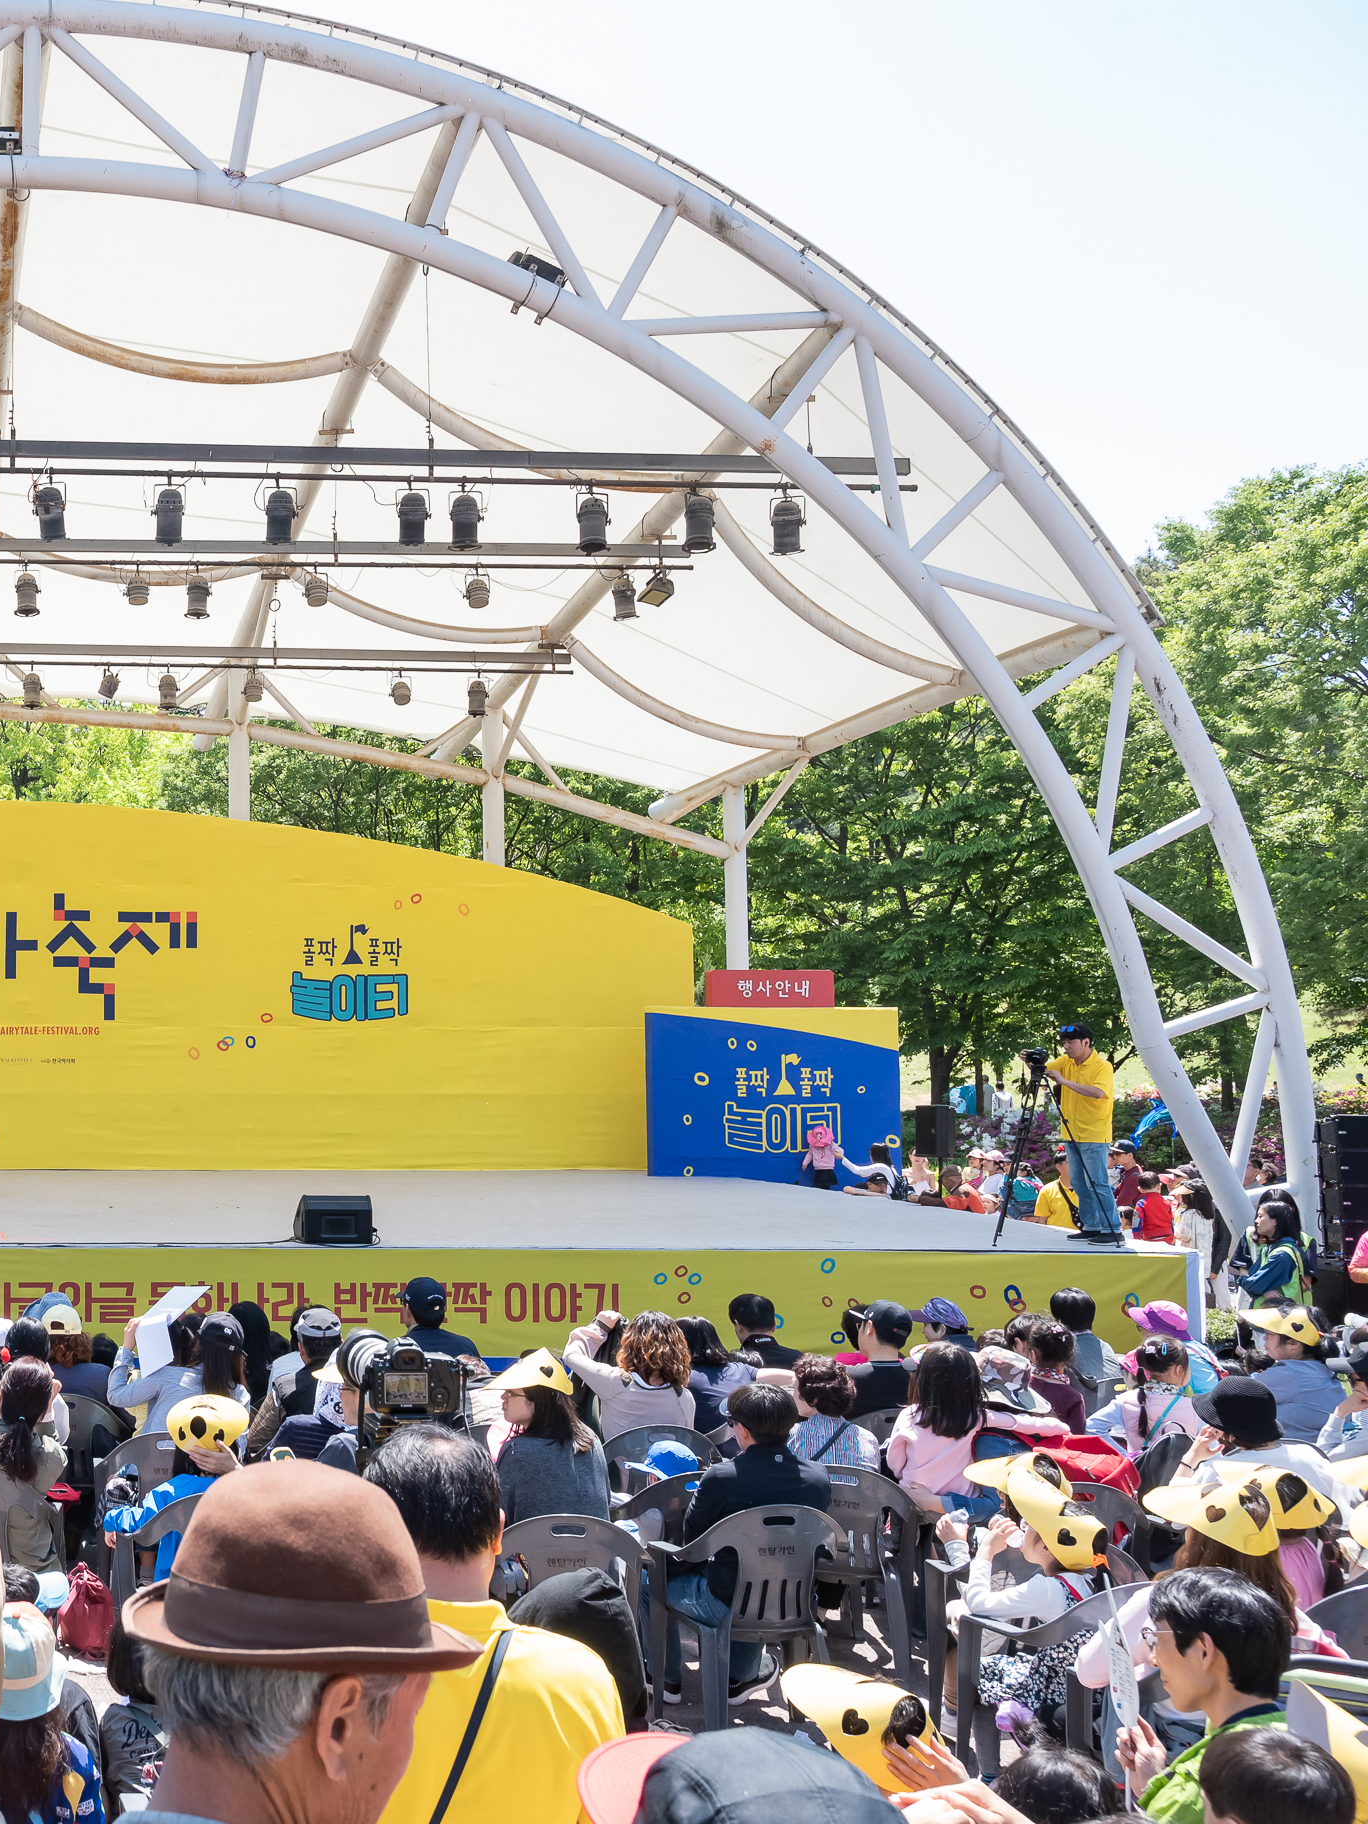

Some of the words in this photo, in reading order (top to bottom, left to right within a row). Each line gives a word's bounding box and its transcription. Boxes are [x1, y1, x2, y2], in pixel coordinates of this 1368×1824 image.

[303, 938, 338, 966] 폴짝
[368, 938, 402, 966] 폴짝
[290, 971, 408, 1021] 놀이터
[735, 1067, 770, 1097] 폴짝
[799, 1067, 834, 1097] 폴짝
[723, 1101, 842, 1153] 놀이터
[333, 1282, 493, 1324] 반짝짝
[504, 1282, 620, 1323] 이야기
